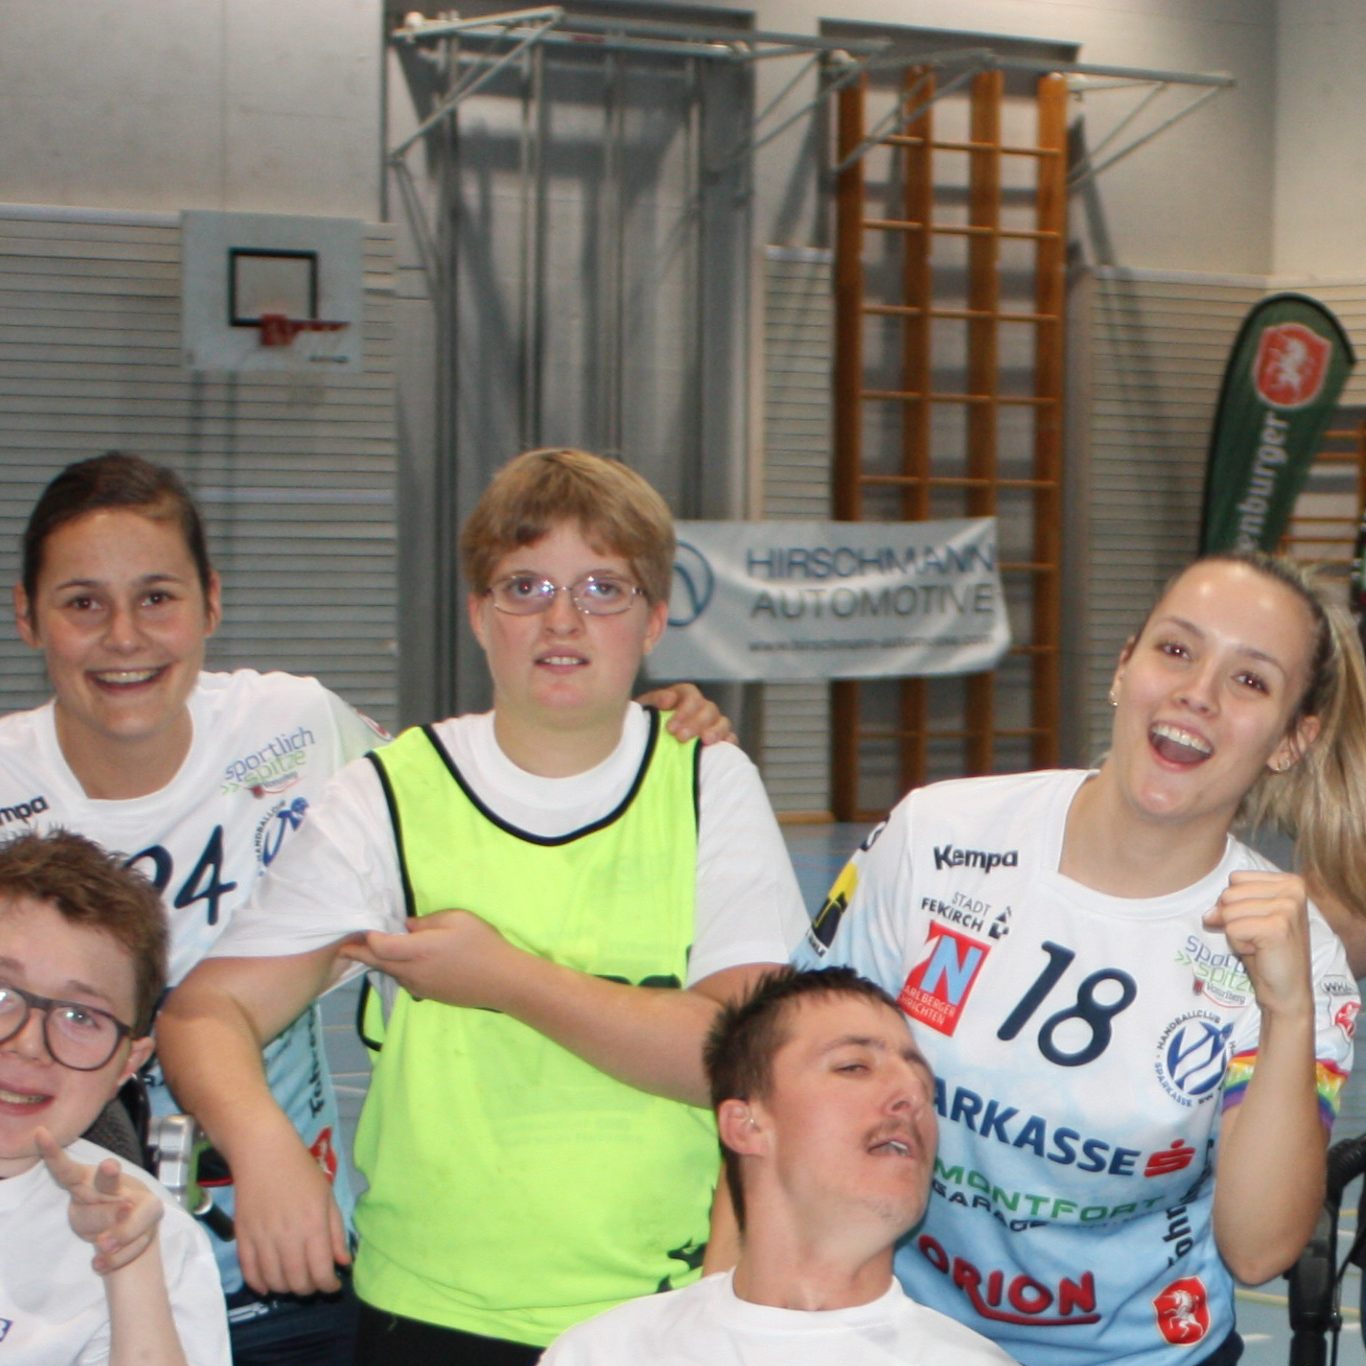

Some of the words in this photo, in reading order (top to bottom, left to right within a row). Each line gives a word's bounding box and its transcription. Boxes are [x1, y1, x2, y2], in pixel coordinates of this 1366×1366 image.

[747, 546, 994, 579] HIRSCHMANN
[750, 583, 995, 618] AUTOMOTIVE
[224, 727, 316, 782] sportlich
[0, 796, 50, 826] mpa
[933, 844, 1019, 874] Kempa
[951, 891, 992, 916] STADT
[1198, 965, 1257, 994] spitz
[995, 940, 1137, 1067] 18
[1156, 1009, 1221, 1051] HANDBALLCLUB
[932, 1076, 1142, 1176] ARKASSE
[934, 1157, 1166, 1222] MONTFORT
[919, 1234, 1101, 1326] ORION
